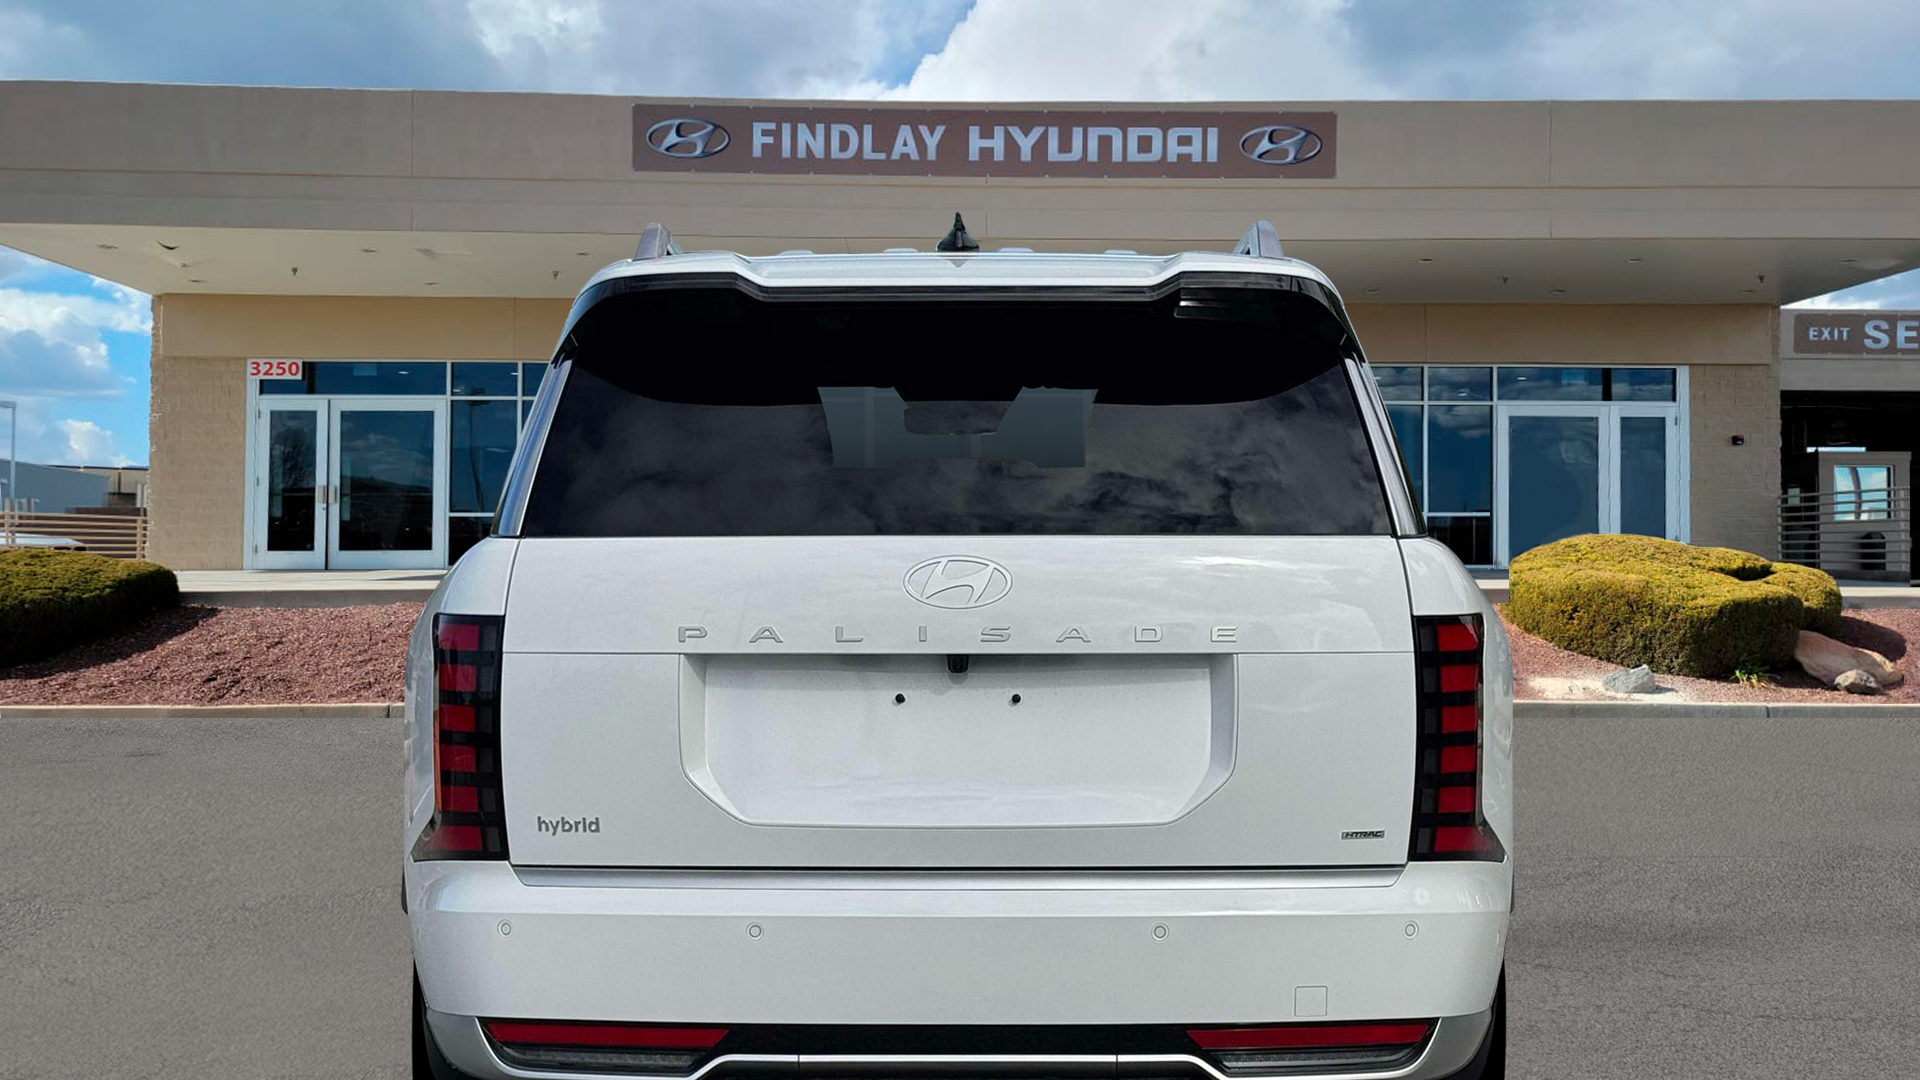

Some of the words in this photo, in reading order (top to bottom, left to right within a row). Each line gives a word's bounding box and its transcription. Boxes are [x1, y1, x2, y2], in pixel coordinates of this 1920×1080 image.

[752, 122, 946, 161] FINDLAY
[968, 125, 1219, 163] HYUNDAI
[1808, 327, 1850, 341] EXIT
[250, 361, 300, 376] 3250
[678, 625, 1238, 643] PALISADE
[537, 816, 600, 836] hybrid
